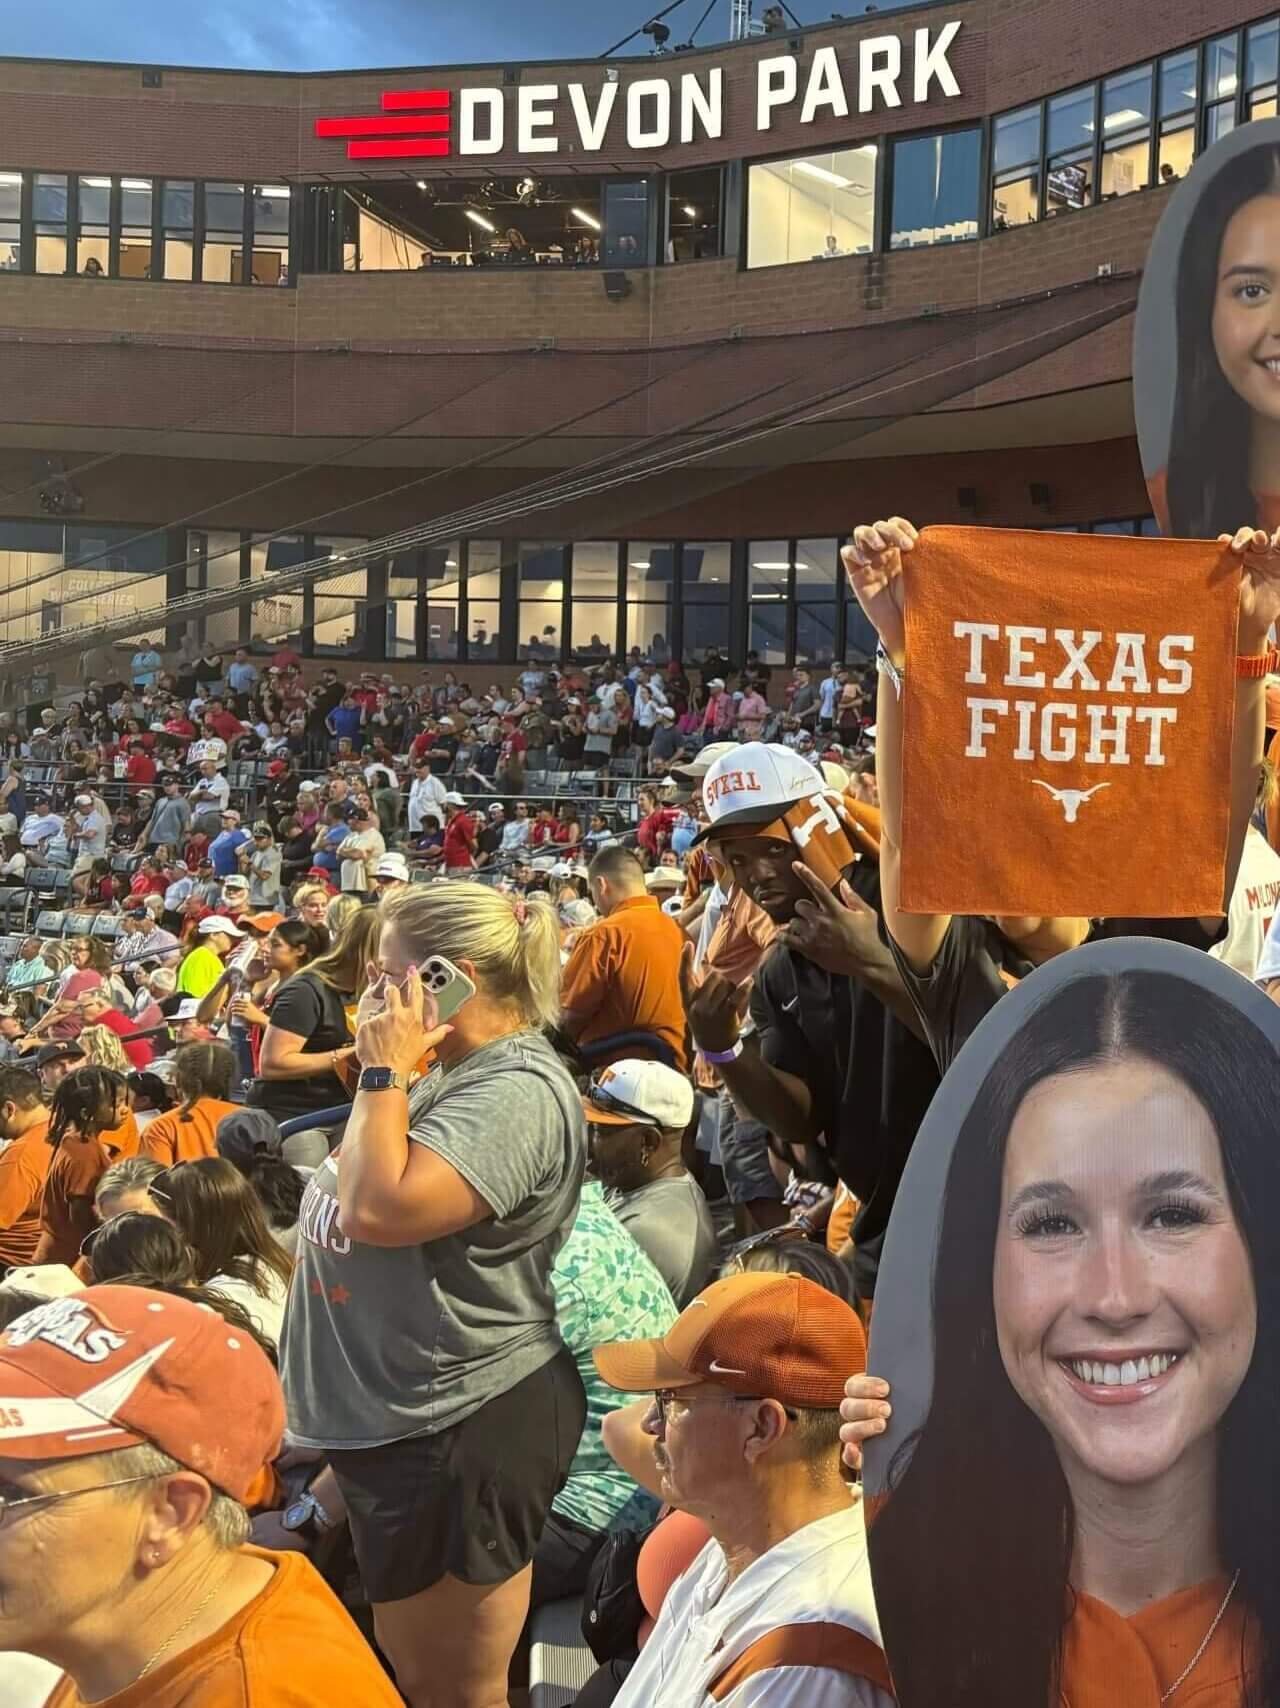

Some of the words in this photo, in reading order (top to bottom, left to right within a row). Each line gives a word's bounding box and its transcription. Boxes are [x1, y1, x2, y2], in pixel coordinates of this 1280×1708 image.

[459, 67, 722, 156] DEVON
[757, 20, 963, 131] PARK
[953, 621, 1194, 694] TEXAS
[965, 697, 1177, 766] FIGHT
[706, 767, 762, 806] TEXAS
